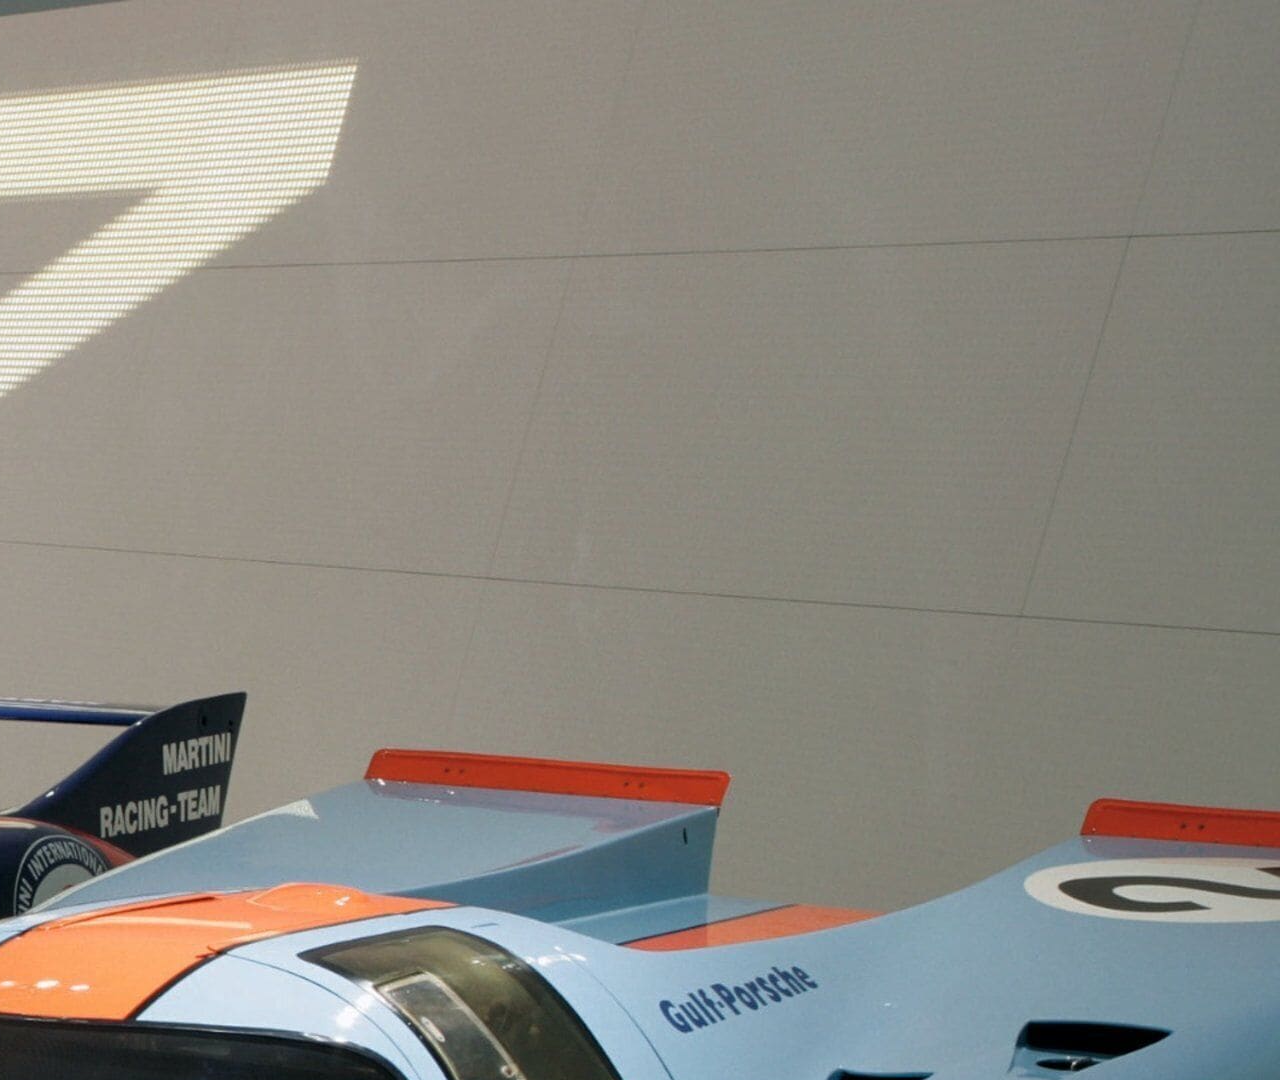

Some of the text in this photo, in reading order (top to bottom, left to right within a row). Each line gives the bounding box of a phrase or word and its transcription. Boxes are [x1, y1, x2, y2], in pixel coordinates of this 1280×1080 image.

[162, 732, 232, 775] MARTINI
[100, 785, 222, 838] RACING-TEAM
[659, 966, 819, 1033] Gulf-Porsche
